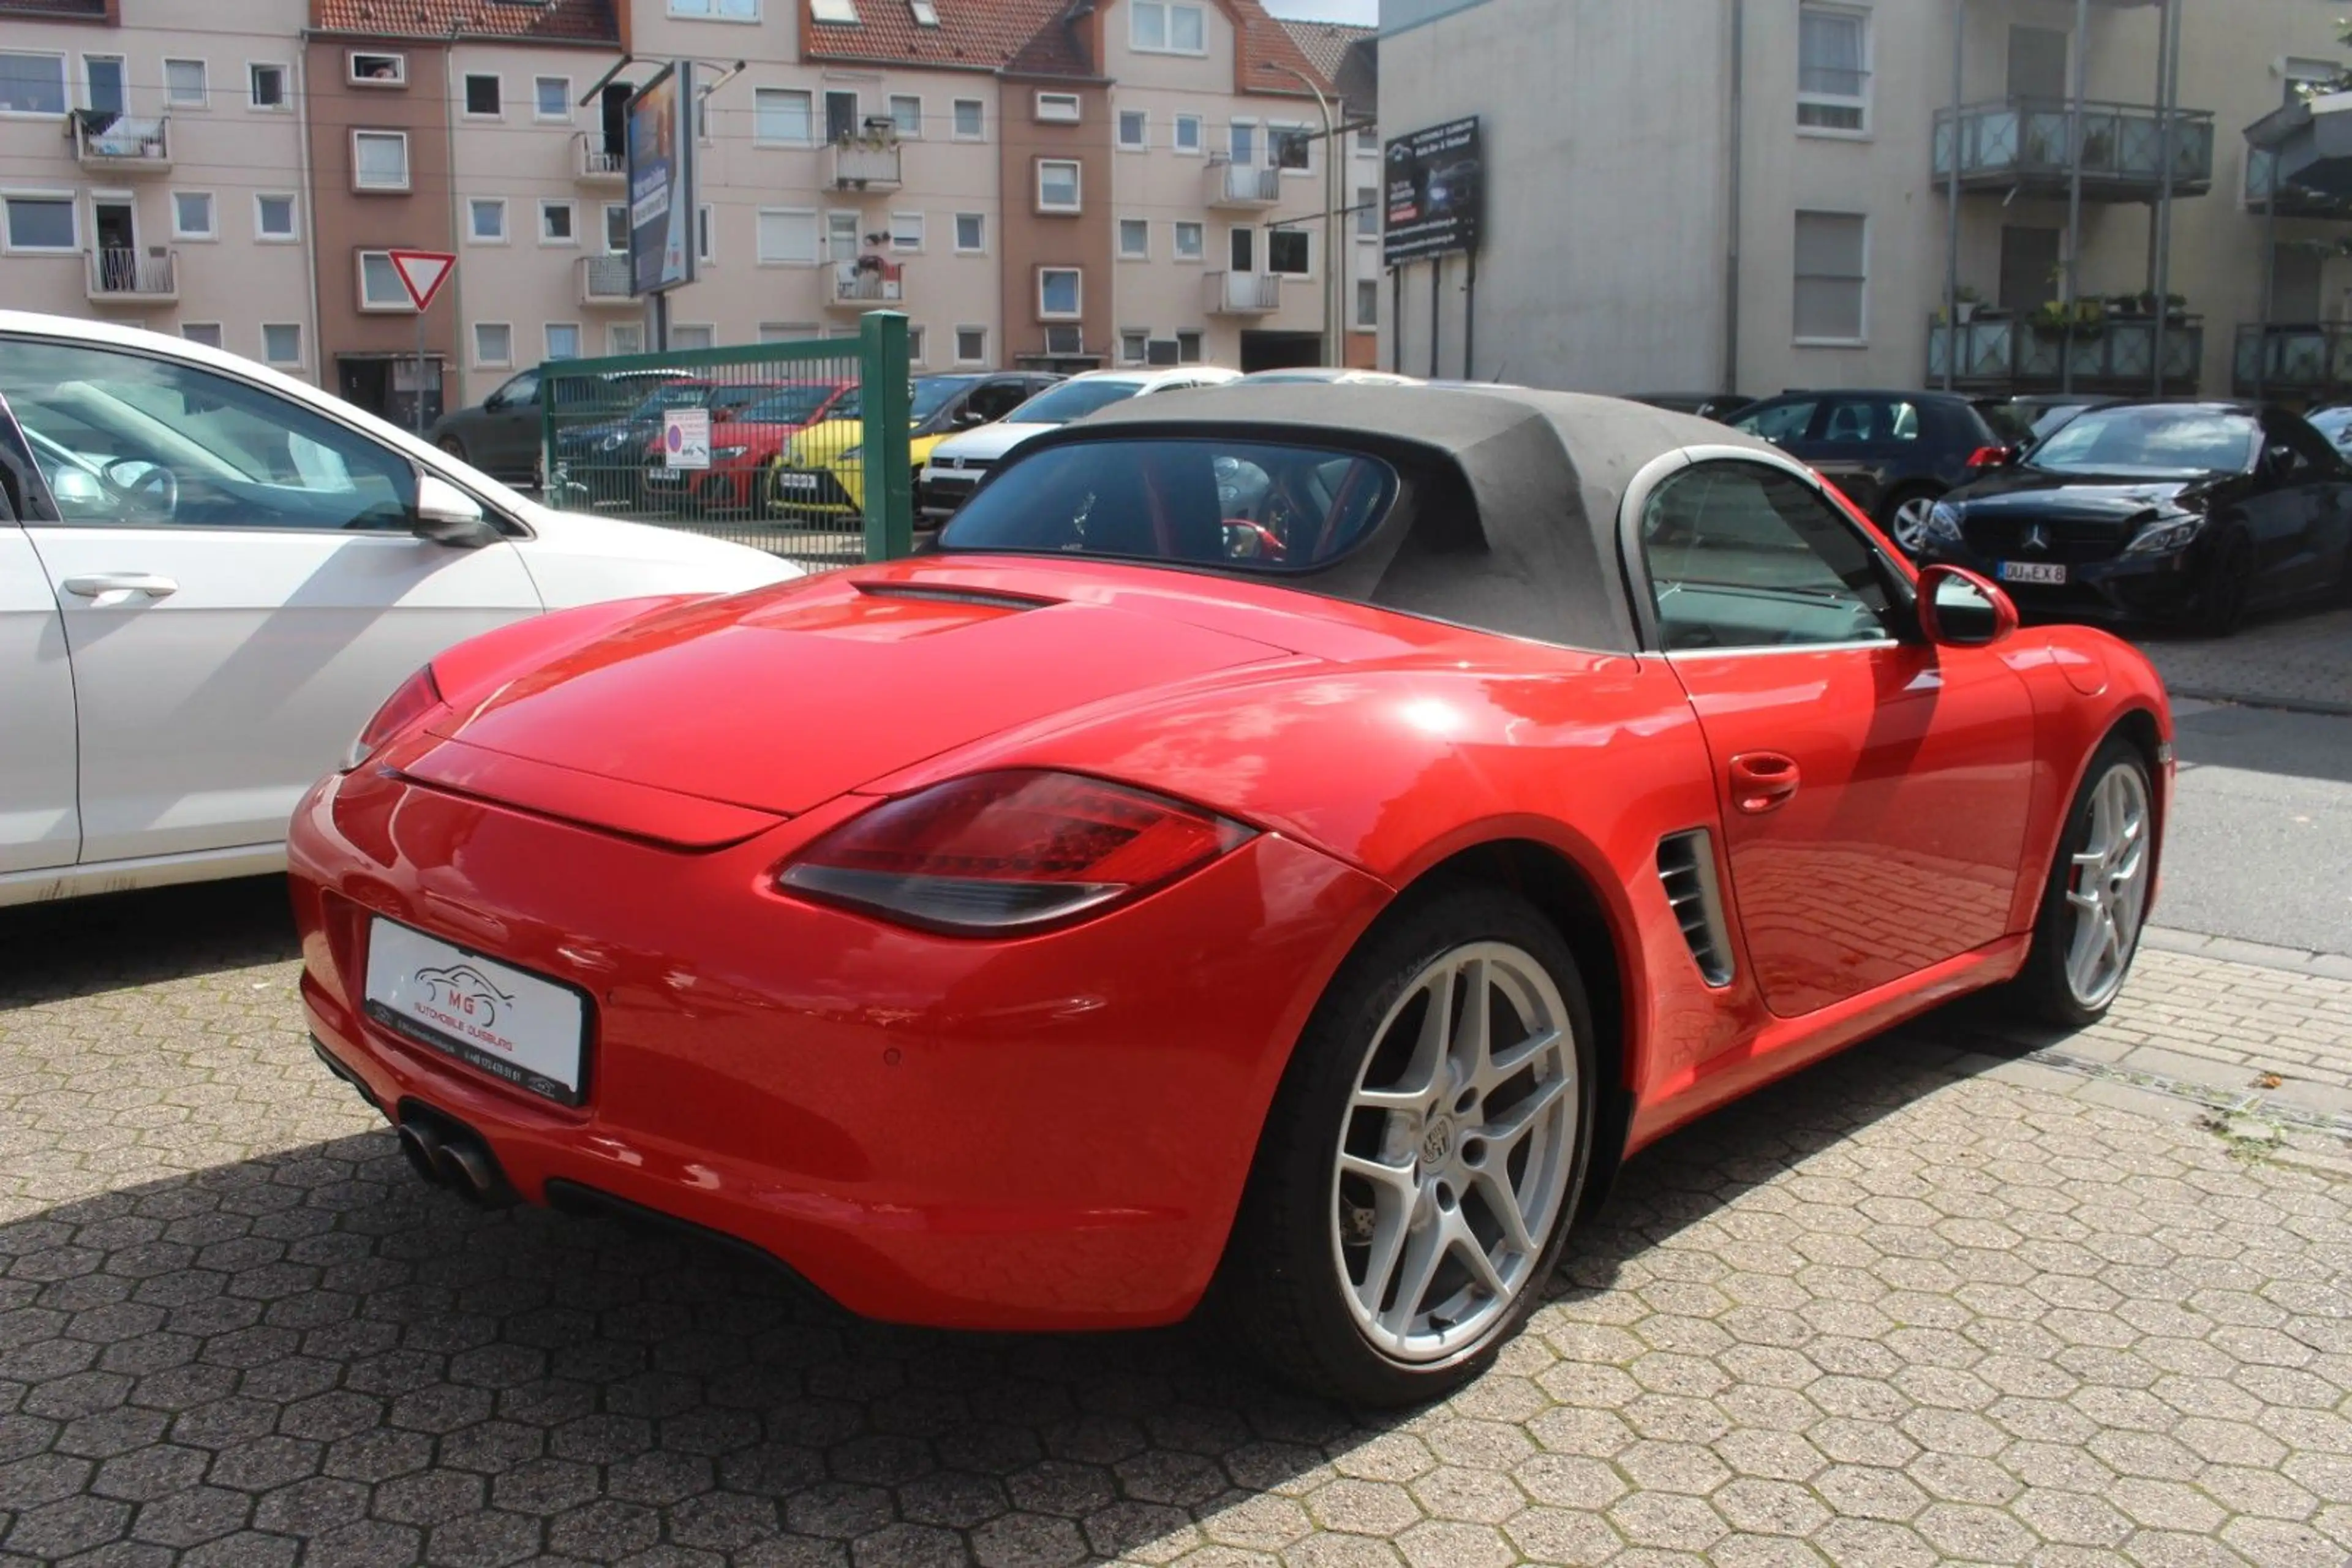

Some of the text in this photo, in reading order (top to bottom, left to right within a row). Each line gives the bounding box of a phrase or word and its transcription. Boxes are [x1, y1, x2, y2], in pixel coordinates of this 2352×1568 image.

[2007, 564, 2065, 582] DU EX 8
[414, 1001, 464, 1031] AUTOMOBILE
[467, 1023, 513, 1052] DUISBURG
